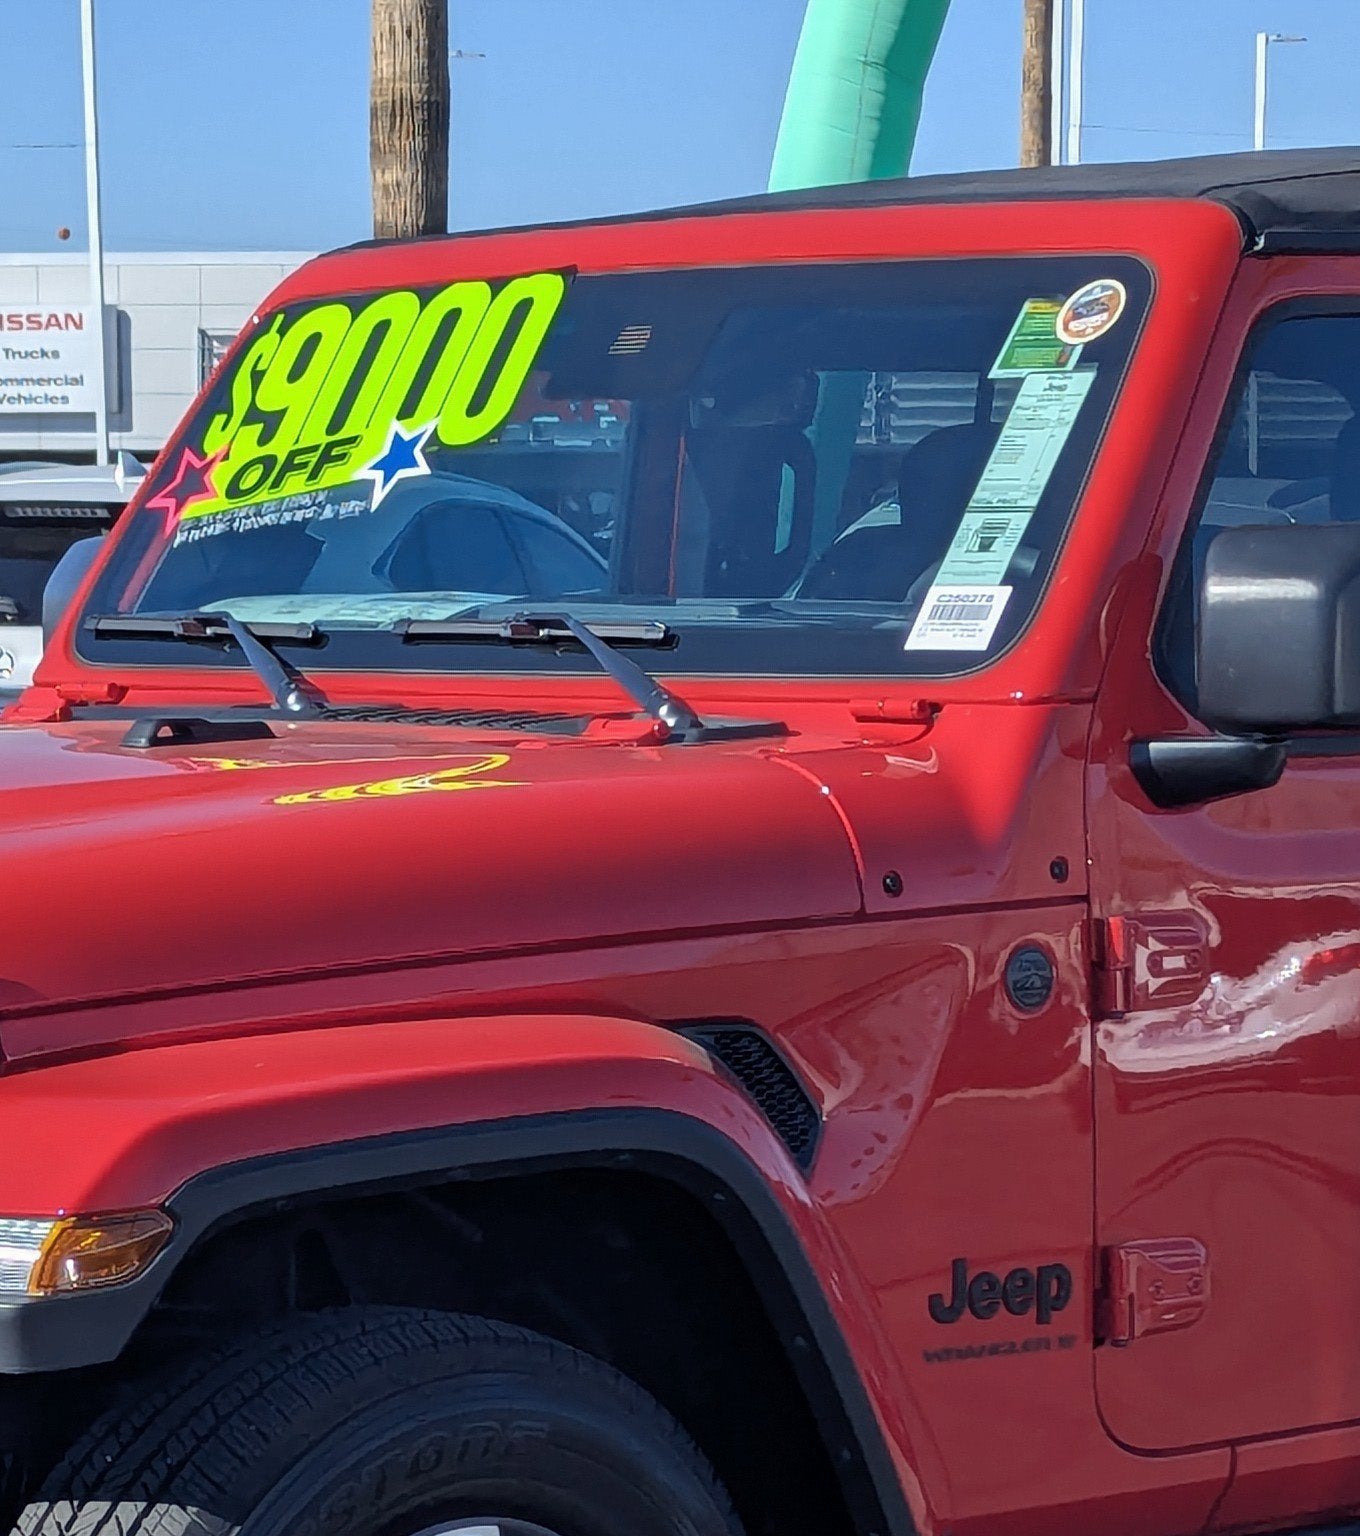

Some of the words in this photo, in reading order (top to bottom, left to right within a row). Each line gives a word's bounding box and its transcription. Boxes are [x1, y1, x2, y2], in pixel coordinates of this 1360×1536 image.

[1, 347, 61, 359] Trucks
[203, 272, 565, 447] $9000
[224, 434, 363, 503] OFF
[928, 1257, 1073, 1325] Jeep
